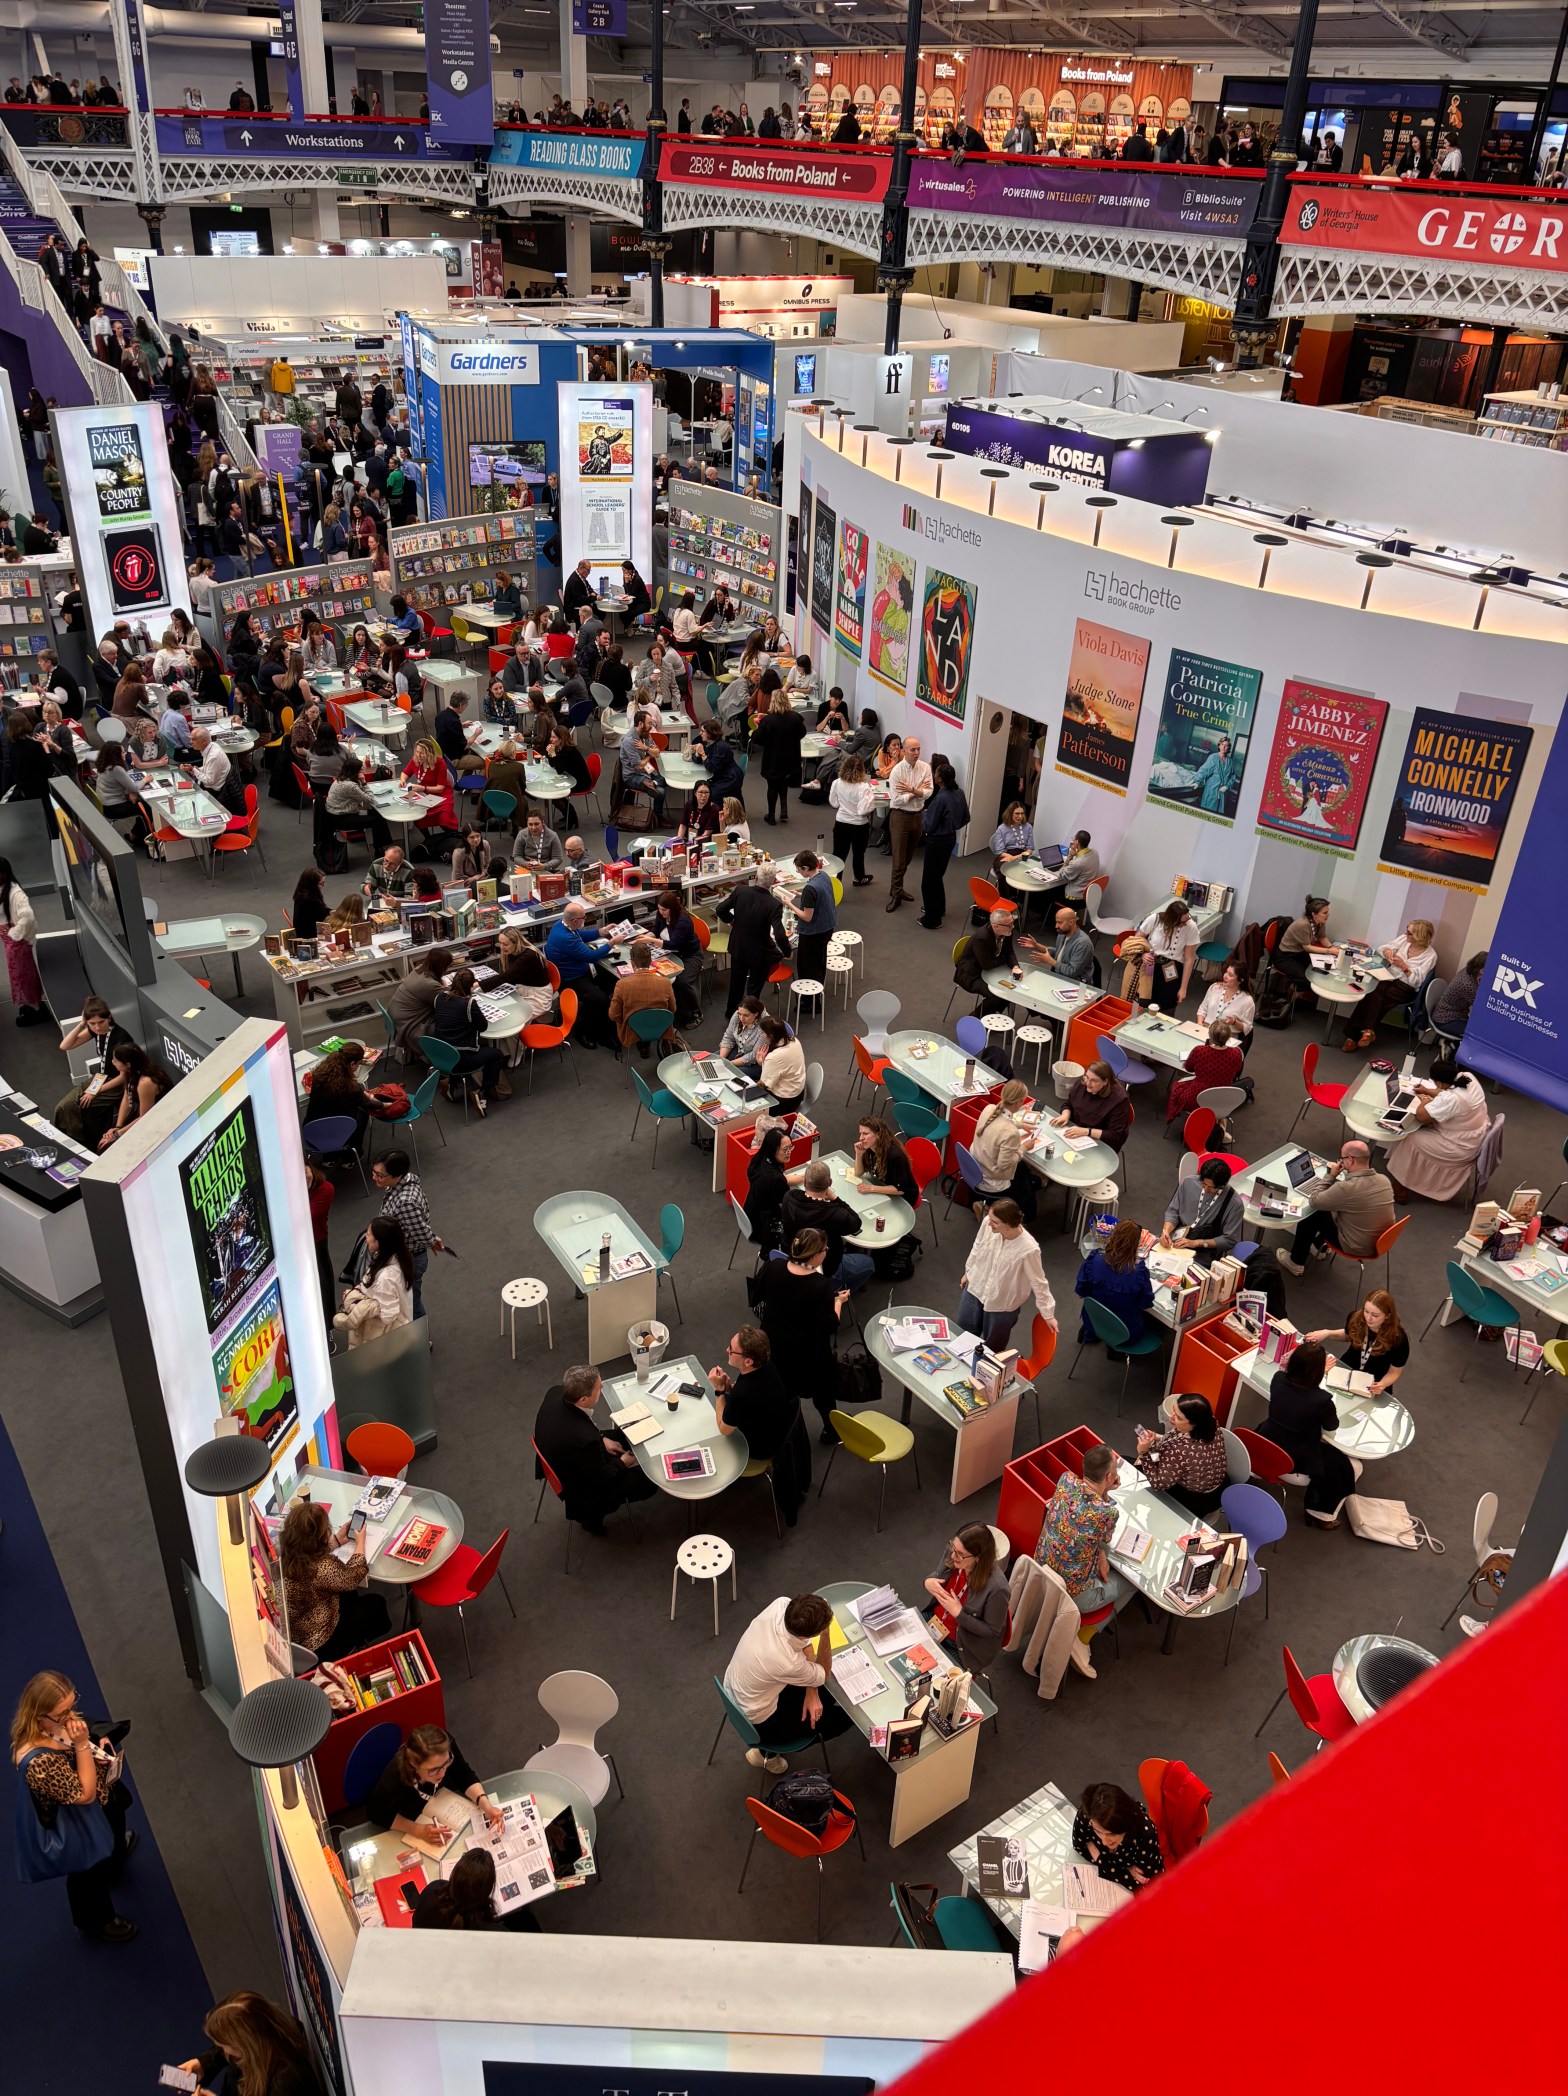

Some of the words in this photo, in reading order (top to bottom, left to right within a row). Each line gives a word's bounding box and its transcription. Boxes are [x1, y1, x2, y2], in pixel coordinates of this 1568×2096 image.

[286, 42, 297, 58] 6E
[1061, 66, 1086, 80] Books
[1087, 69, 1104, 82] from
[1105, 70, 1133, 84] Poland
[286, 134, 364, 148] Workstations
[530, 140, 566, 165] READING
[568, 143, 597, 168] GLASS
[600, 146, 632, 171] BOOKS
[688, 156, 715, 175] 2B38
[731, 160, 764, 180] Books
[766, 165, 792, 184] from
[794, 165, 838, 187] Poland
[925, 180, 965, 194] virtusales
[1002, 186, 1045, 200] POWERING
[1046, 190, 1097, 204] INTELLIGENT
[1098, 194, 1150, 208] PUBLISHING
[1180, 211, 1202, 222] Visit
[1204, 212, 1239, 224] 4WSA3
[1320, 218, 1329, 228] of
[1330, 220, 1358, 232] Georgia
[1354, 210, 1378, 222] House
[246, 322, 276, 332] Vivida
[422, 343, 437, 368] Gardners
[450, 353, 528, 370] Gardners
[91, 430, 135, 447] DANIEL
[952, 422, 971, 434] 6D105
[94, 444, 138, 461] MASON
[1048, 445, 1106, 476] KOREA
[1024, 461, 1062, 480] RIGHTS
[1062, 472, 1105, 490] CENTRE
[100, 486, 143, 502] COUNTRY
[682, 486, 702, 496] hachette
[107, 498, 140, 511] PEOPLE
[756, 505, 774, 518] hachette
[847, 530, 859, 549] GO
[939, 516, 982, 547] hachette
[339, 564, 366, 576] hachette
[229, 582, 258, 594] hachette
[932, 572, 968, 596] MAGGIE
[1109, 571, 1182, 611] hachette
[840, 597, 859, 622] MARIA
[1108, 596, 1127, 608] BOOK
[1128, 602, 1155, 616] GROUP
[838, 612, 860, 640] SEMPLE
[1078, 630, 1108, 656] Viola
[1110, 640, 1144, 666] Davis
[1072, 678, 1104, 701] Judge
[1104, 688, 1135, 711] Stone
[1179, 666, 1242, 699] Patricia
[918, 684, 962, 716] O'FARRELL
[1170, 682, 1248, 718] Cornwell
[1175, 702, 1199, 720] True
[1202, 710, 1233, 729] Crime
[1306, 704, 1356, 725] ABBY
[1086, 732, 1106, 746] James
[1288, 716, 1368, 745] JIMENEZ
[1062, 731, 1126, 772] Patterson
[1414, 728, 1514, 773] MICHAEL
[1407, 758, 1510, 801] CONNELLY
[1150, 797, 1165, 806] Grand
[1166, 801, 1184, 812] Central
[1184, 806, 1211, 821] Publishing
[1211, 816, 1228, 826] Group
[1409, 790, 1491, 824] IRONWOOD
[1260, 829, 1277, 840] Grand
[1278, 833, 1298, 846] Central
[1299, 839, 1329, 854] Publishing
[1329, 847, 1348, 859] Group
[1389, 867, 1407, 877] Little,
[1408, 870, 1428, 882] Brown
[1429, 876, 1442, 884] and
[1442, 879, 1474, 892] Company
[1500, 954, 1520, 968] Built
[1521, 961, 1532, 971] by
[1492, 964, 1545, 1009] RX
[1486, 1002, 1516, 1021] building
[1517, 1015, 1558, 1039] businesses
[1495, 998, 1510, 1009] the
[1510, 1003, 1542, 1024] business
[194, 1157, 217, 1207] ALL
[216, 1116, 246, 1172] HAIL
[204, 1156, 244, 1231] CHAOS
[213, 1297, 231, 1320] SARAH
[231, 1284, 244, 1300] REES
[243, 1254, 267, 1287] BRENNAN
[212, 1324, 229, 1345] Little,
[228, 1302, 246, 1325] Brown
[245, 1286, 260, 1304] Book
[259, 1266, 275, 1287] Group
[217, 1320, 255, 1375] KENNEDY
[256, 1294, 277, 1325] RYAN
[404, 1522, 428, 1544] WOMEN
[397, 1543, 432, 1560] DEFIANT
